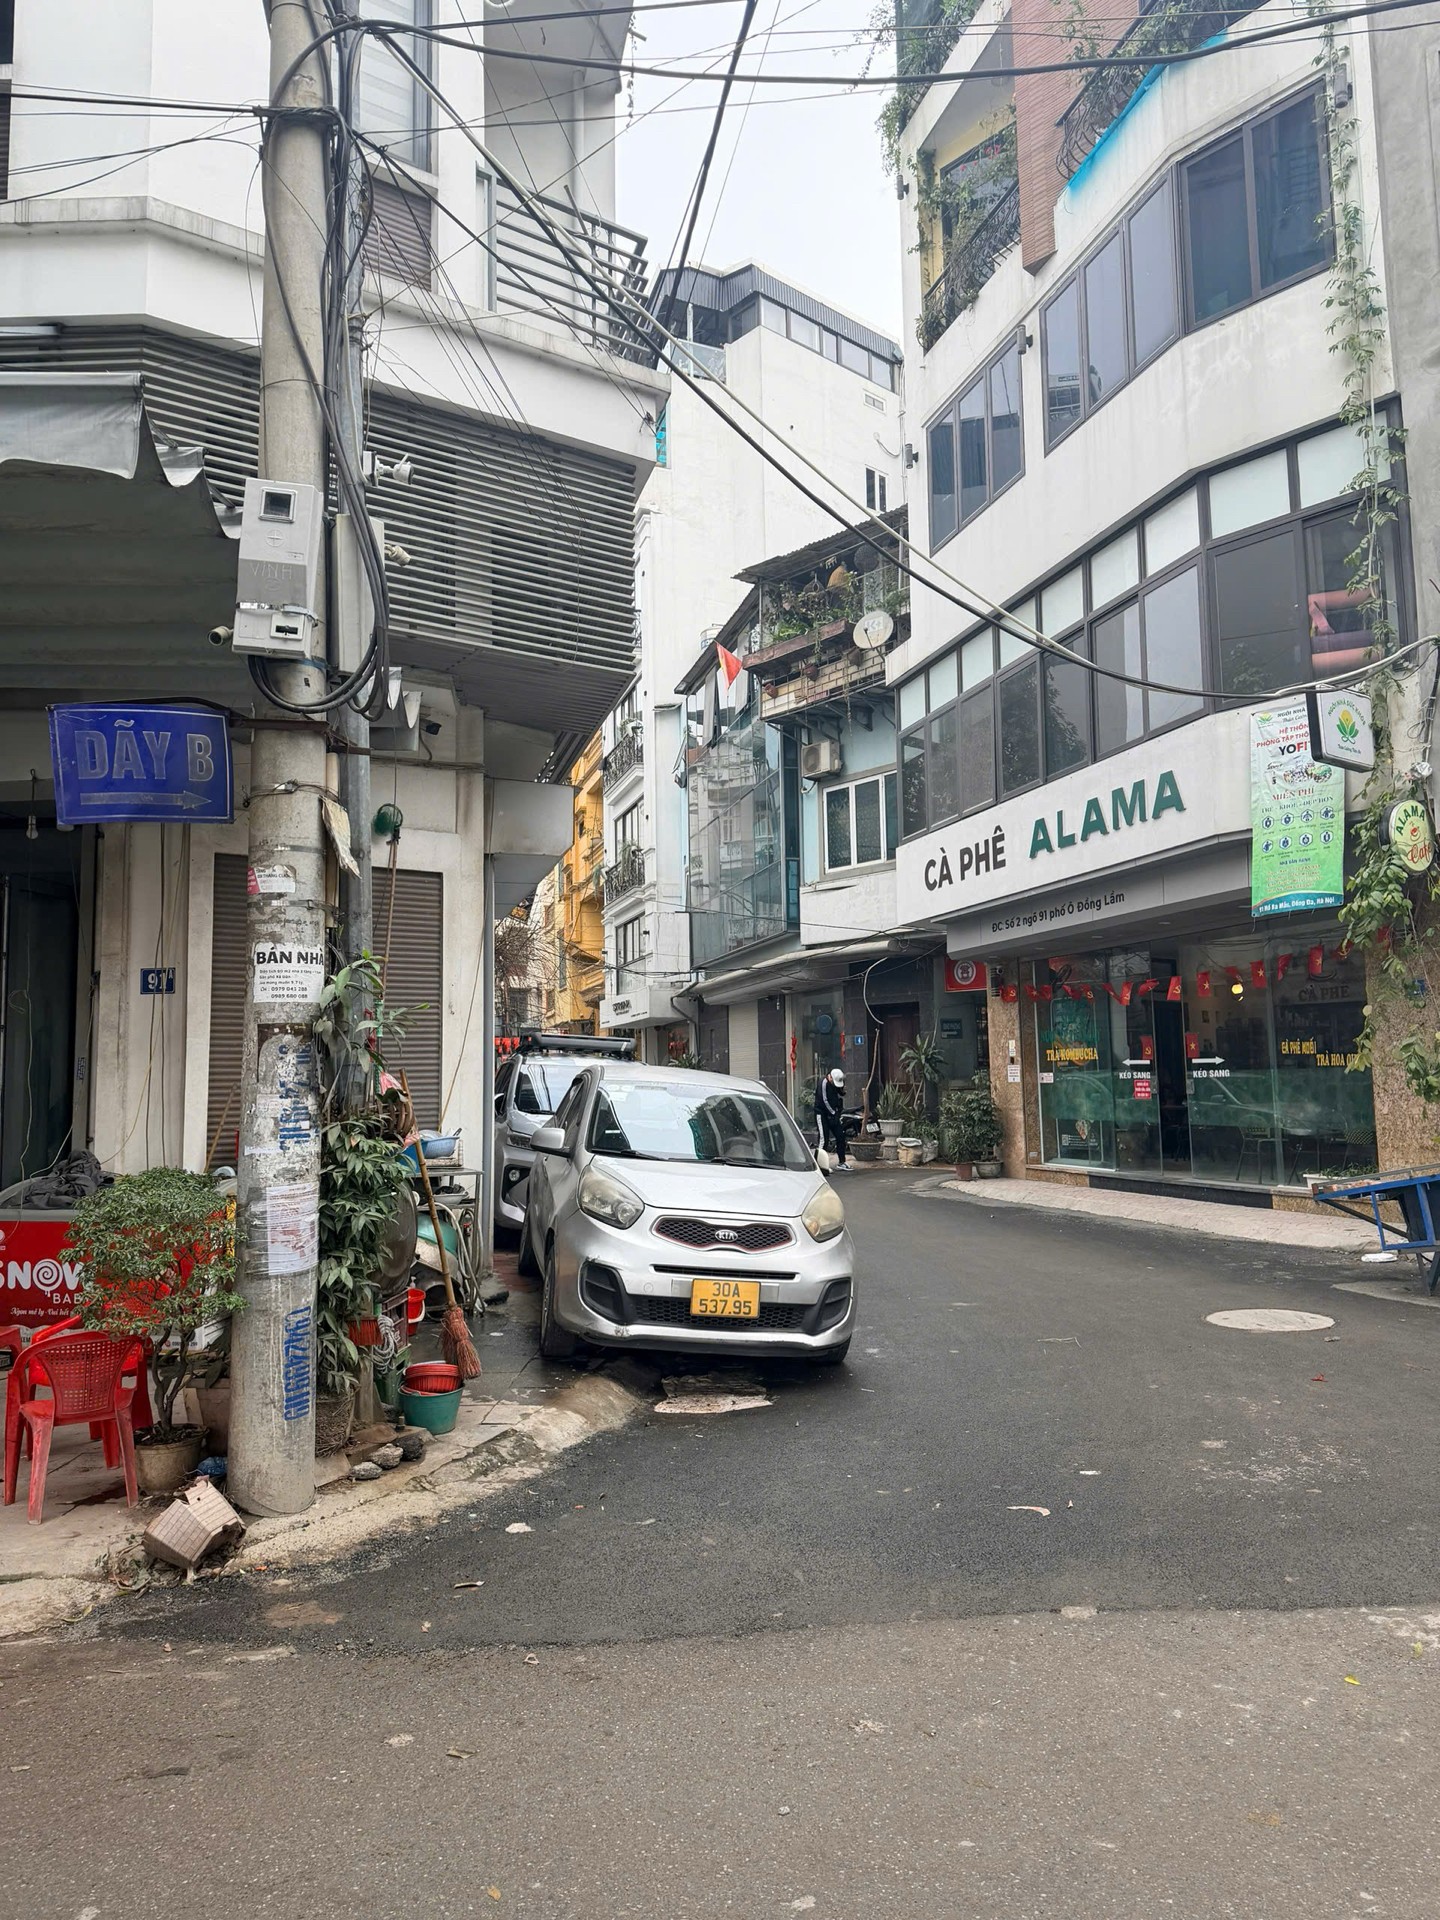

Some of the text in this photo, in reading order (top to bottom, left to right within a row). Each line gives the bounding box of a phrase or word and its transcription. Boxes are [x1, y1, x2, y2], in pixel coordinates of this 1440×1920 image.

[1290, 723, 1309, 732] THỐN
[74, 719, 214, 782] DÃY B
[1279, 741, 1310, 756] YOFI
[1396, 805, 1425, 836] ALAMA
[923, 769, 1186, 891] CÀ PHÊ ALAMA
[1005, 917, 1015, 930] Số
[1016, 917, 1021, 927] 2
[1038, 909, 1048, 922] 91
[1049, 903, 1066, 921] phố
[1077, 896, 1102, 912] Đồng
[256, 946, 324, 966] BÁN NHÀ
[1046, 1045, 1099, 1061] TRÀ KOMBUCHA
[1281, 1038, 1289, 1054] CÀ
[1289, 1038, 1301, 1054] PHÊ
[1316, 1050, 1330, 1066] TRÀ
[1330, 1053, 1345, 1066] HOA
[1119, 1070, 1151, 1079] KÉO SANG
[1192, 1067, 1230, 1078] KÉO SANG
[718, 1232, 735, 1240] KIA
[712, 1282, 740, 1298] 30A
[698, 1298, 752, 1315] 537.95
